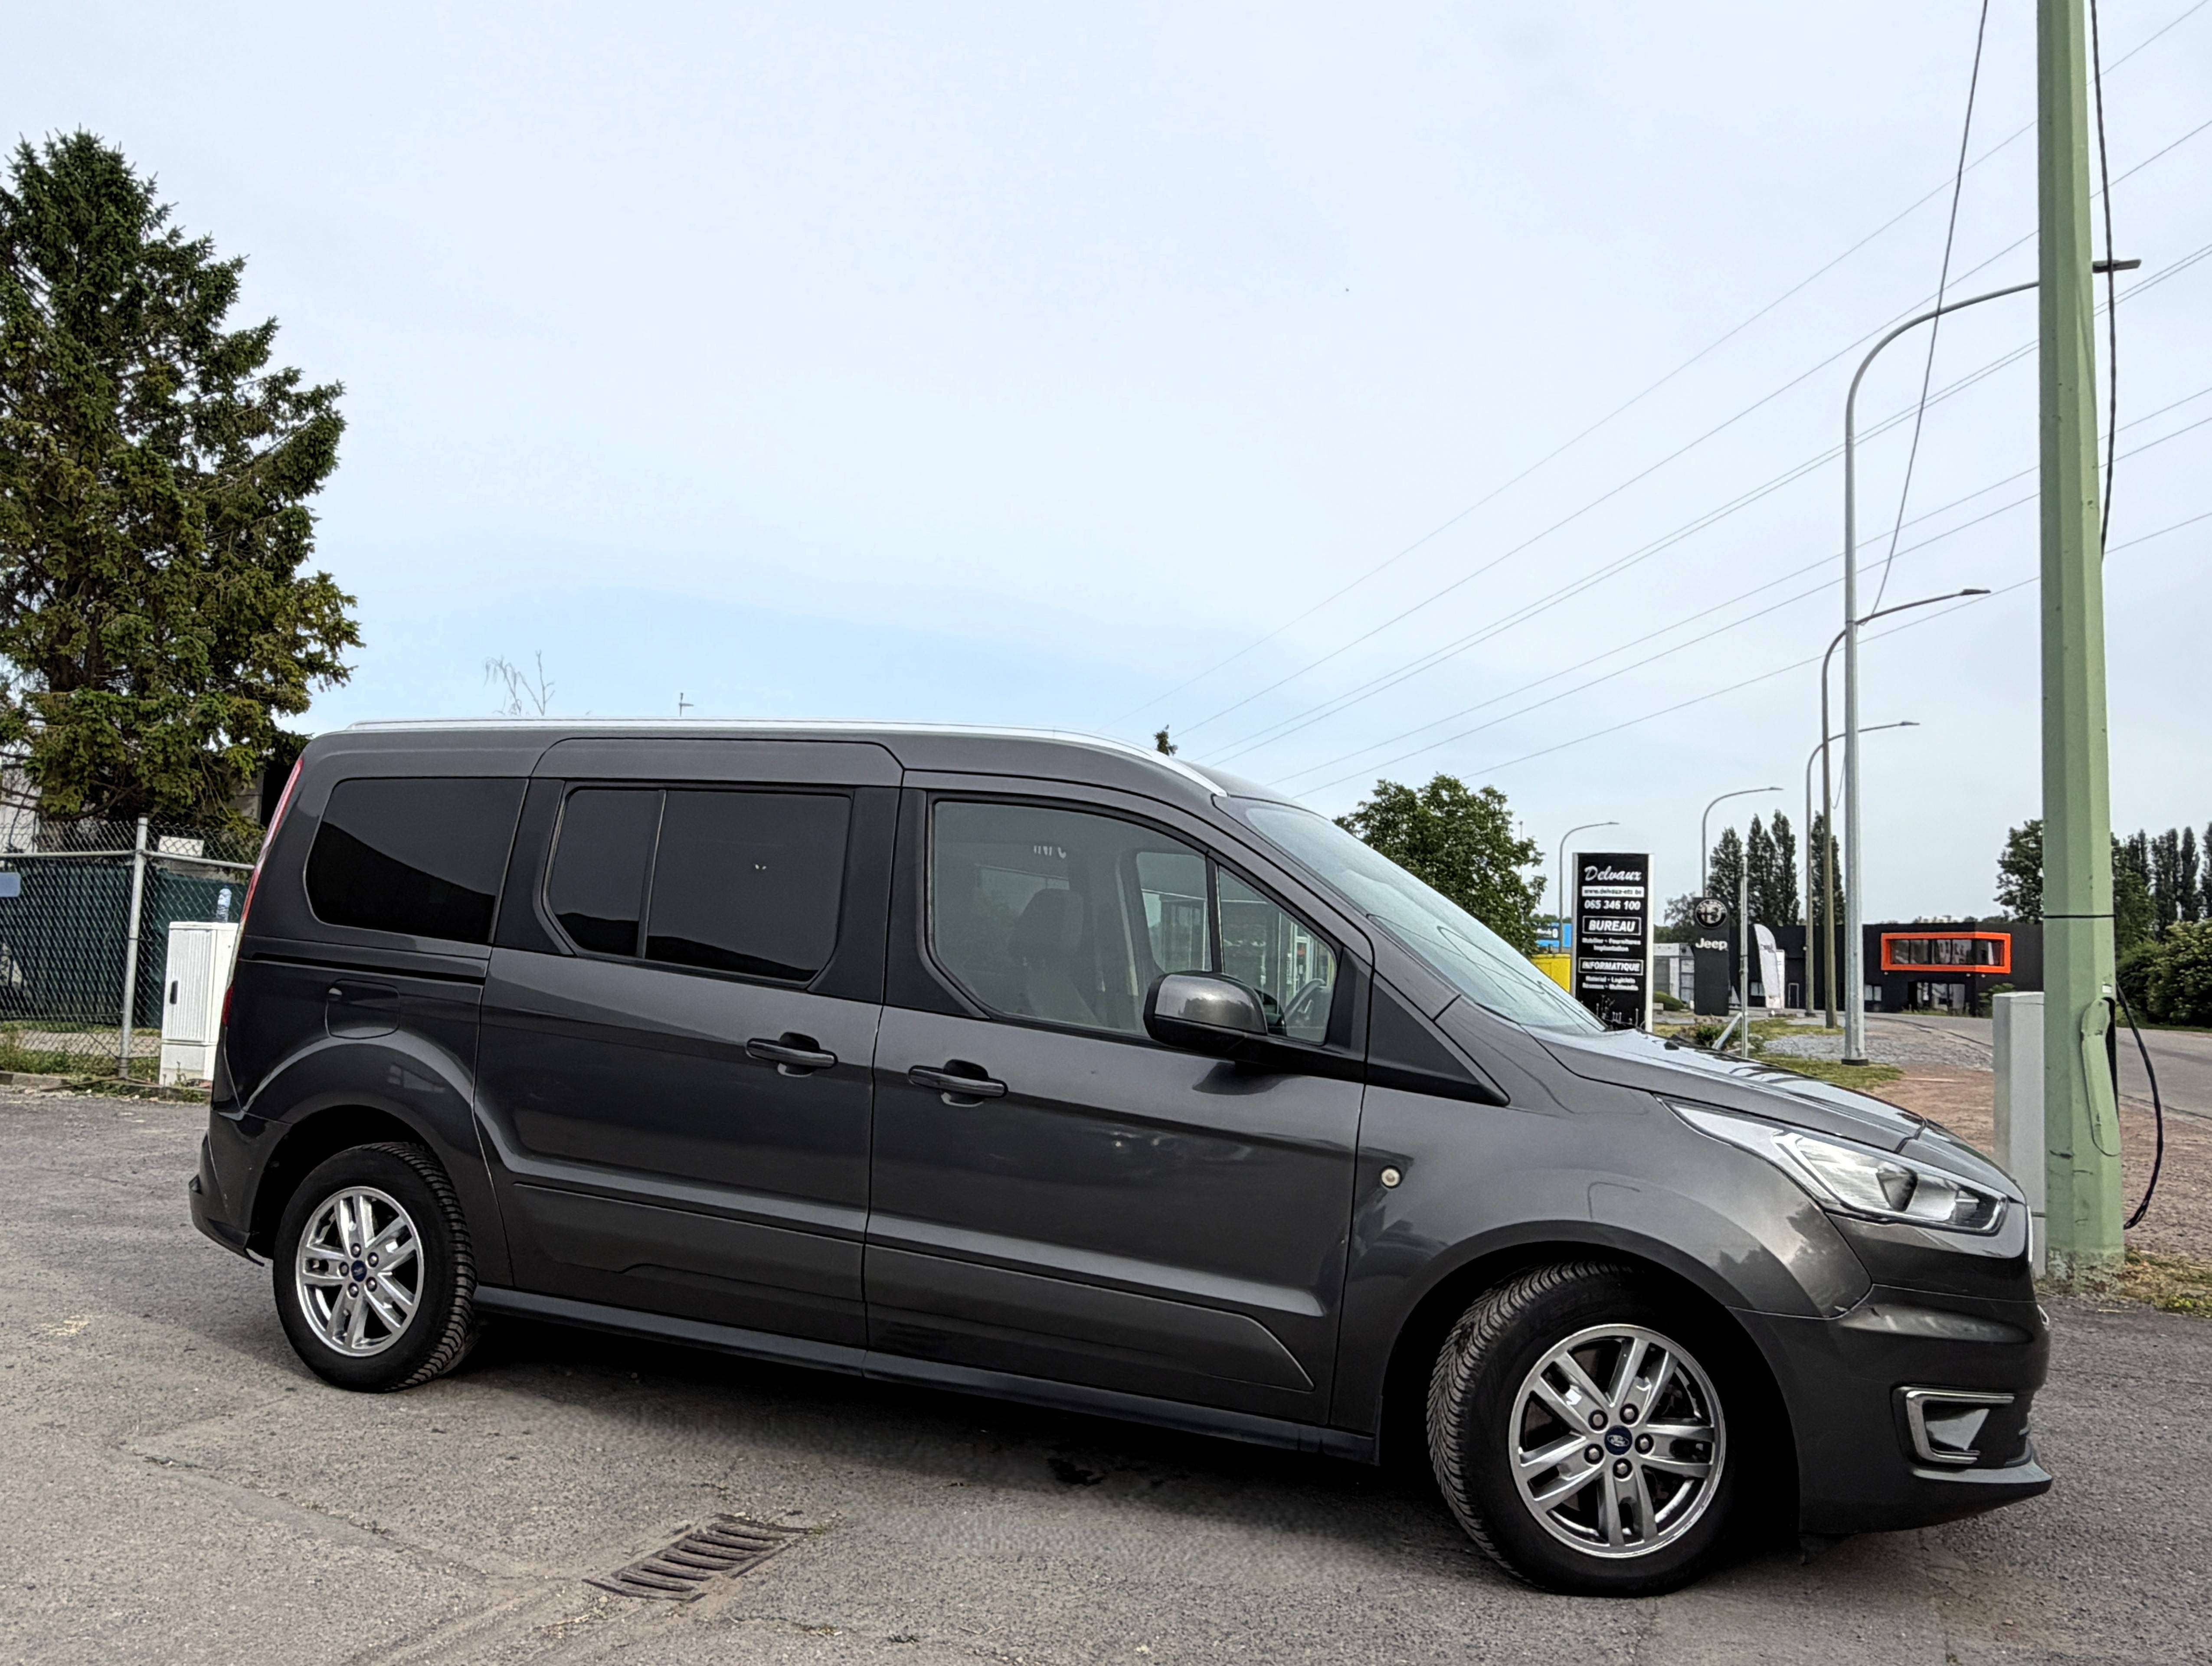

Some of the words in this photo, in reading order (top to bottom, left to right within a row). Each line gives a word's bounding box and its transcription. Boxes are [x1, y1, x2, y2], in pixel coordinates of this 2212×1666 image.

[1584, 866, 1642, 881] Delvaux
[1624, 900, 1641, 910] 100
[1588, 920, 1636, 932] BUREAU
[1695, 938, 1728, 951] Jeep
[1582, 961, 1640, 972] INFORMATIQUE
